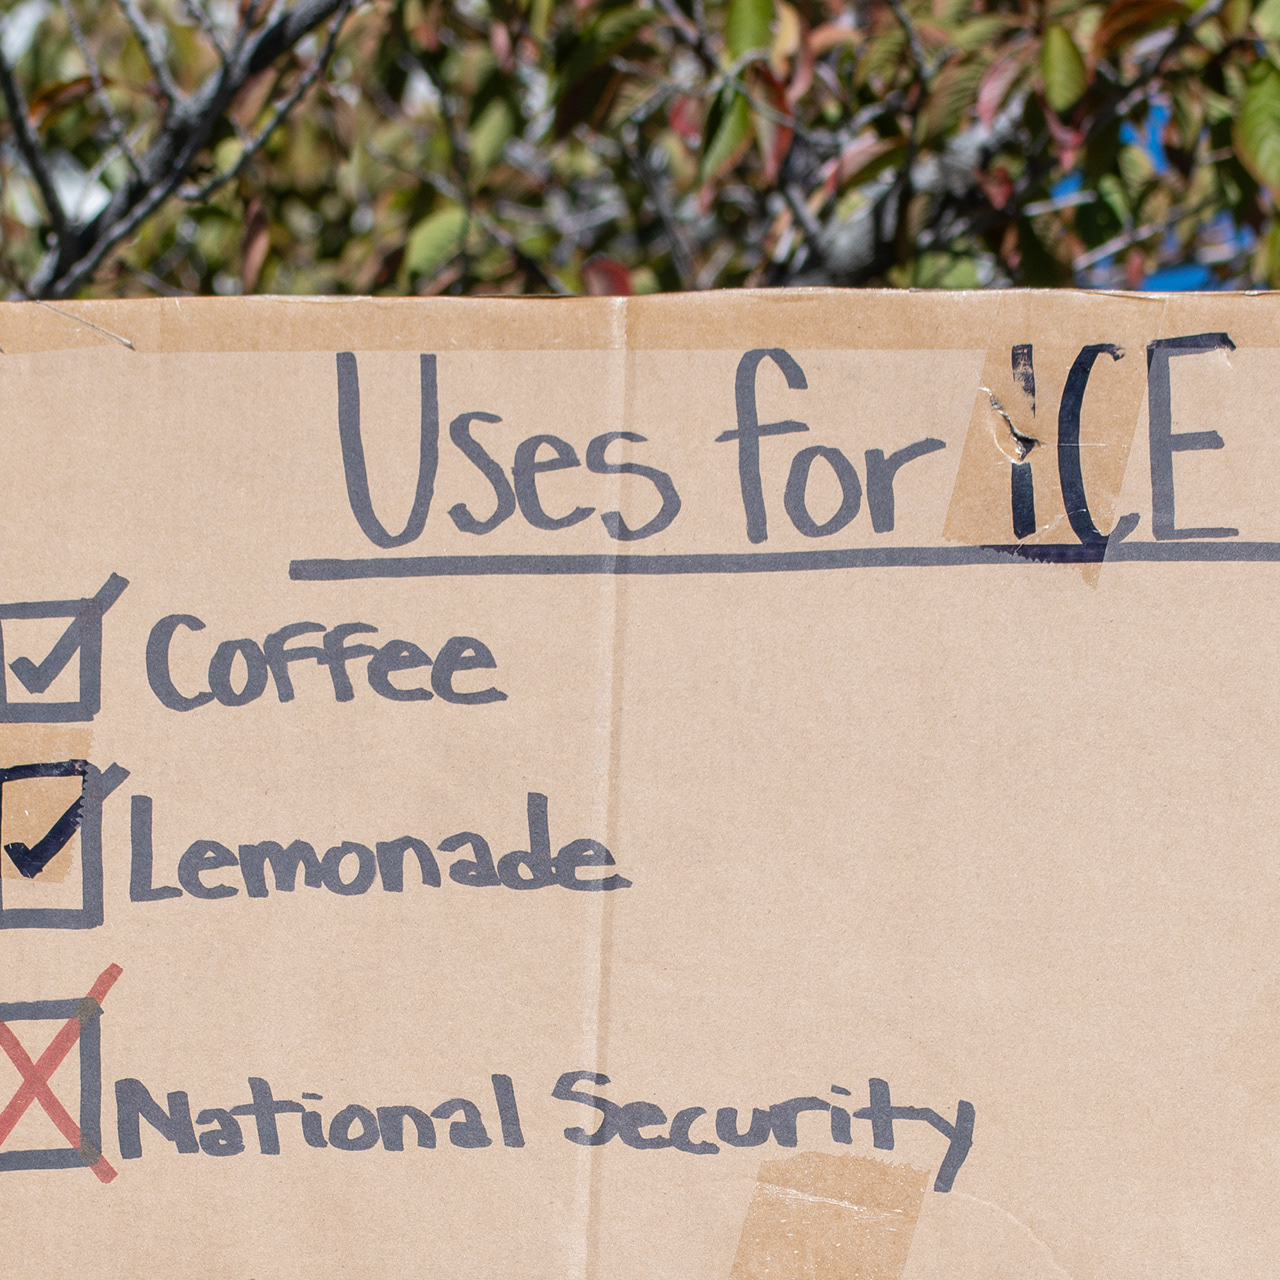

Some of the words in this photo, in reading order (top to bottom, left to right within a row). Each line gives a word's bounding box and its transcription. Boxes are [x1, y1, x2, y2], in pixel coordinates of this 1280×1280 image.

[336, 352, 681, 548] Uses
[715, 348, 946, 543] for
[146, 614, 509, 712] Coffee
[130, 793, 632, 902] Lemonade
[115, 1073, 525, 1159] National
[552, 1071, 975, 1193] Security
